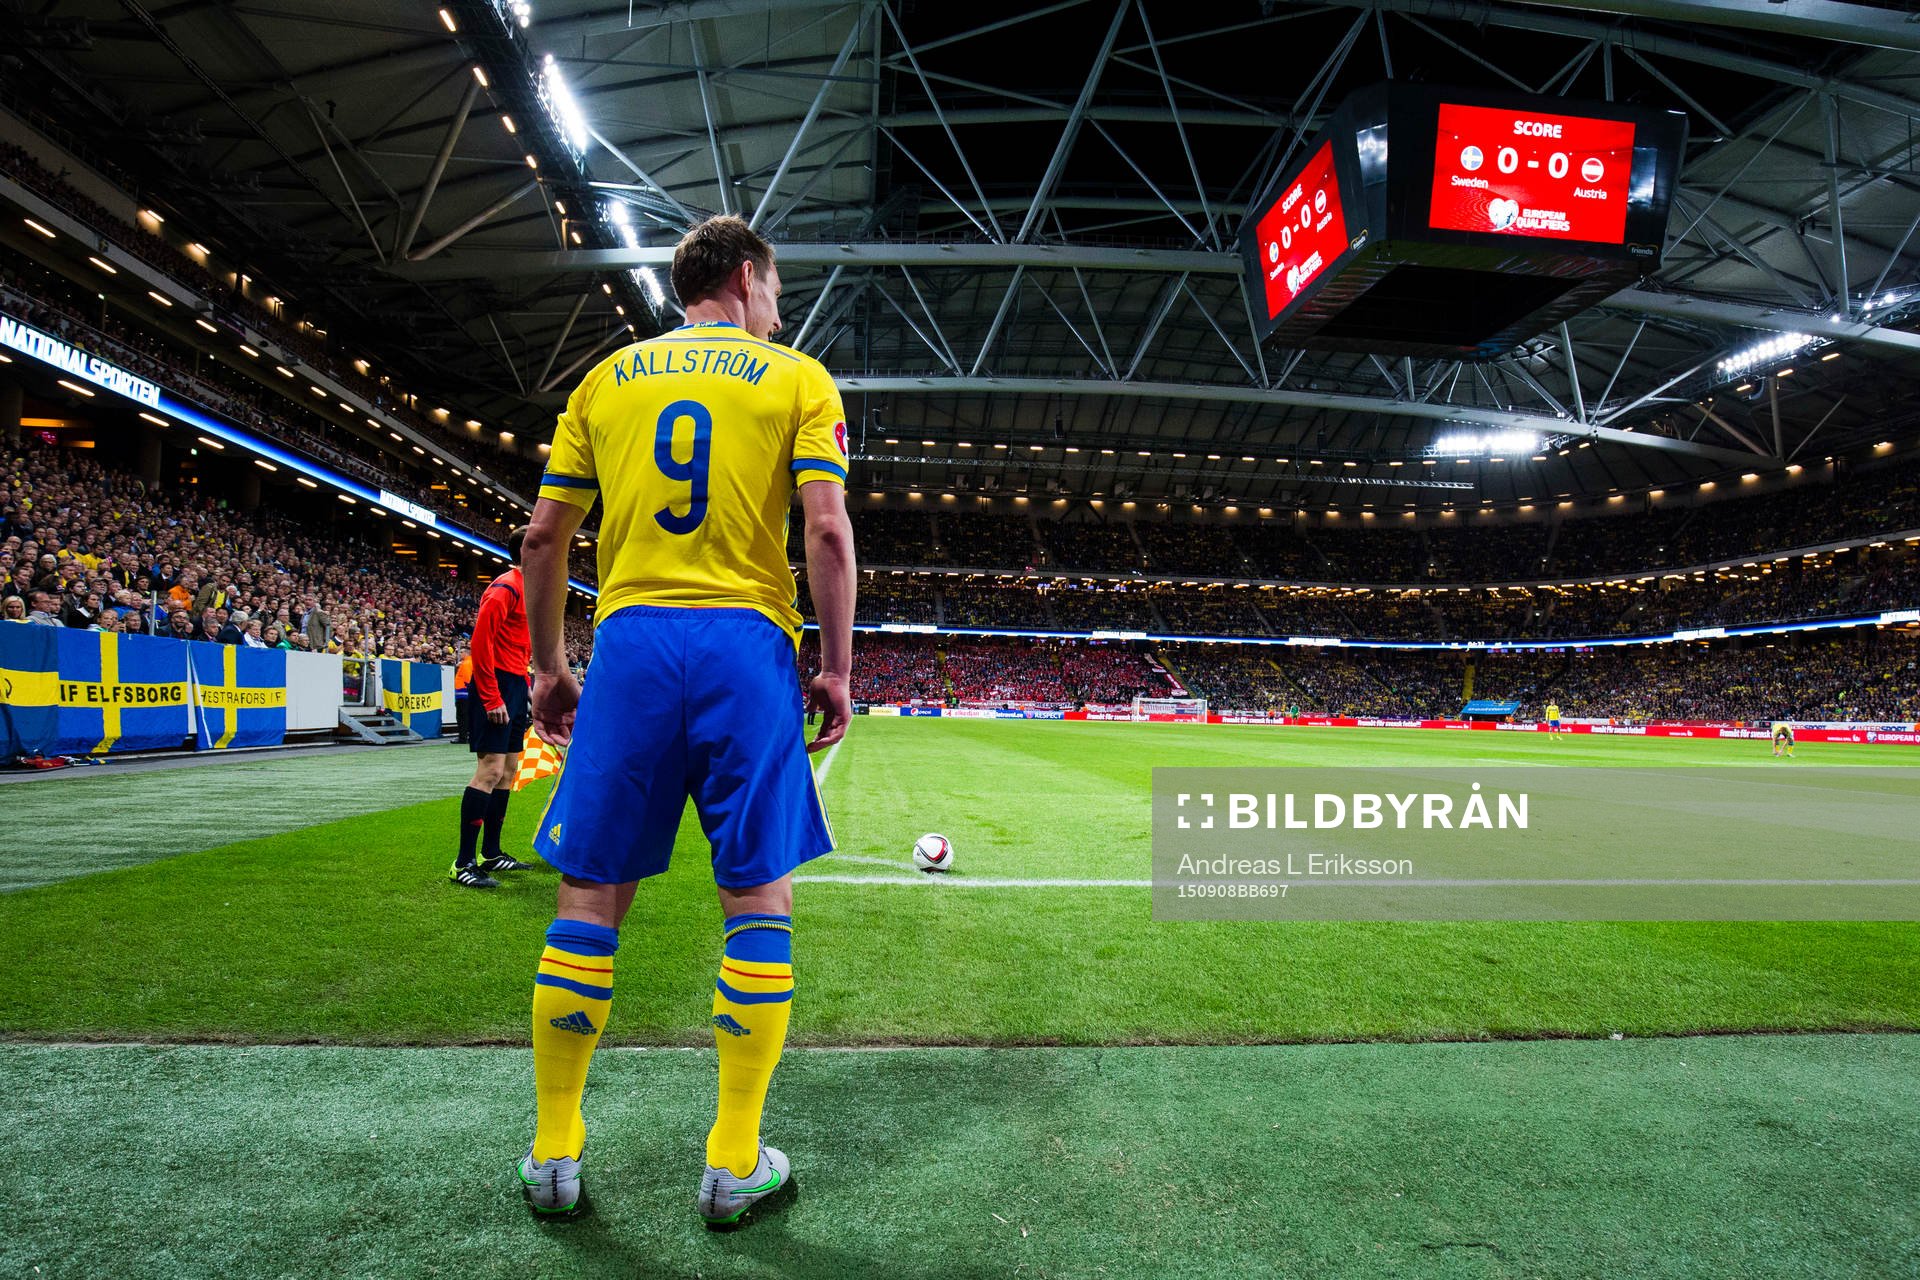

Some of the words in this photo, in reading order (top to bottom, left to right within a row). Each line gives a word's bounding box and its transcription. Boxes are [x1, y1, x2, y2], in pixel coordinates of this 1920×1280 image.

[1513, 120, 1562, 139] SCORE
[1497, 147, 1518, 174] 0
[1548, 152, 1569, 179] 0
[1451, 175, 1489, 189] Sweden
[1282, 183, 1303, 214] SCORE
[1573, 187, 1607, 200] Austria
[1522, 208, 1566, 221] EUROPEAN
[1281, 225, 1292, 249] 0
[1301, 204, 1311, 229] 0
[1516, 217, 1570, 232] QUALIFIERS
[614, 348, 769, 387] KÄLLSTRÖM
[653, 399, 713, 535] 9
[60, 684, 78, 702] IF
[86, 685, 181, 703] ELFSBORG
[1034, 711, 1061, 719] RESPECT
[1878, 734, 1914, 742] EUROPEAN
[550, 1018, 598, 1036] adidas
